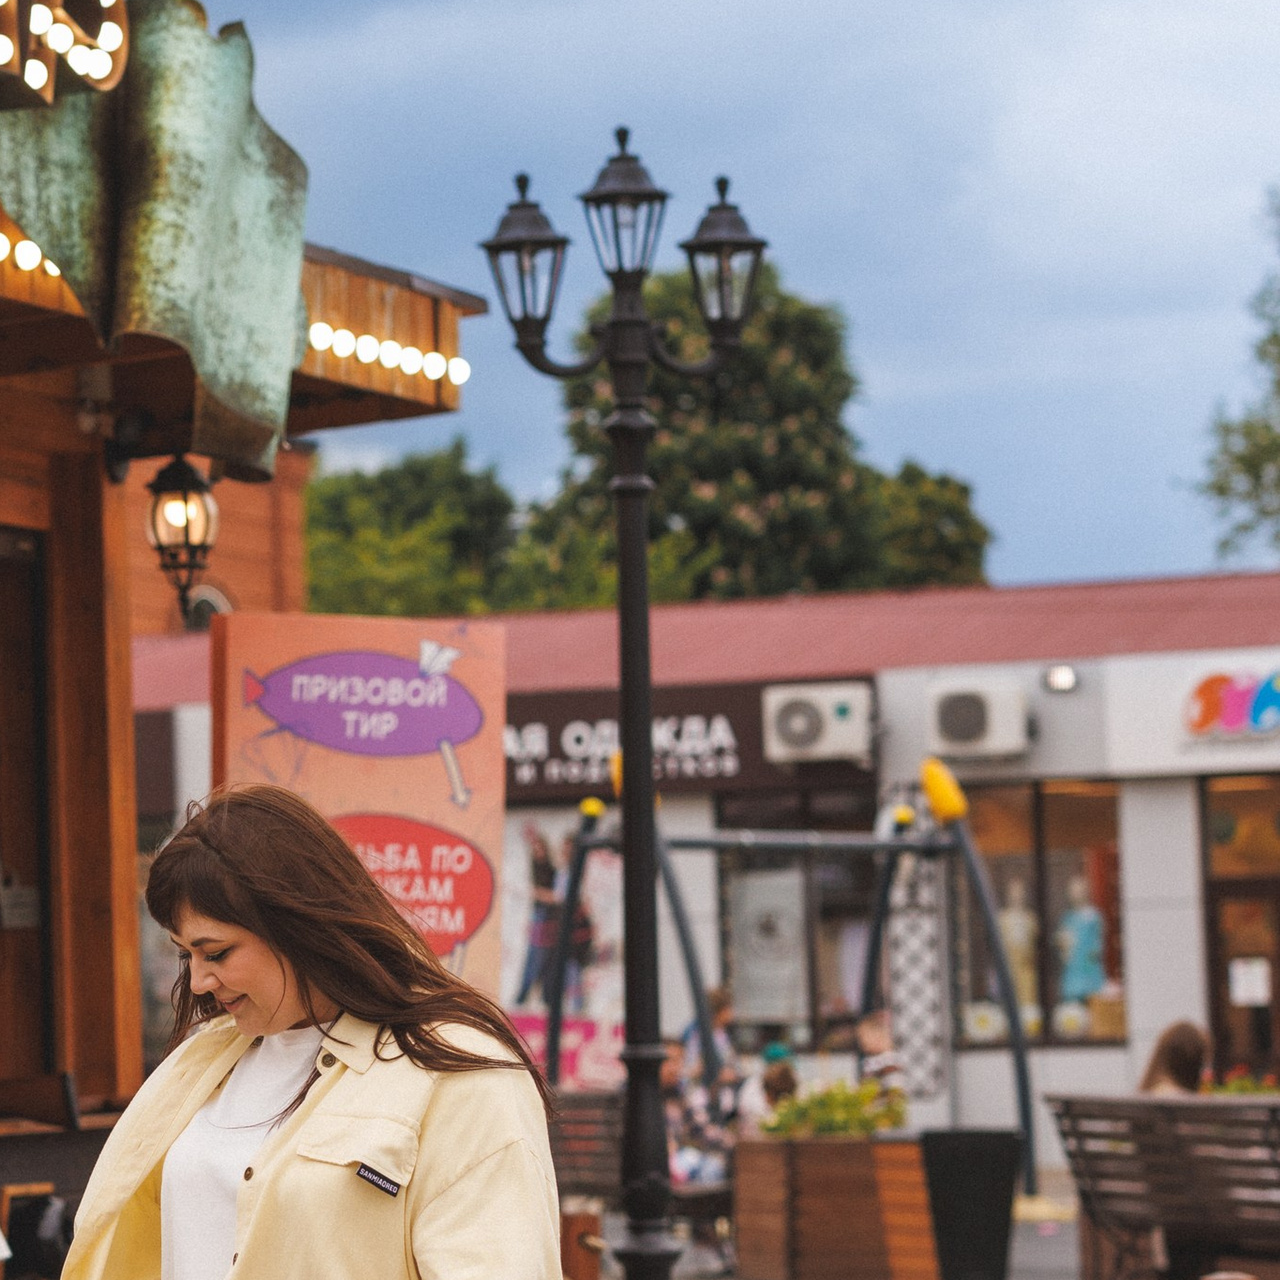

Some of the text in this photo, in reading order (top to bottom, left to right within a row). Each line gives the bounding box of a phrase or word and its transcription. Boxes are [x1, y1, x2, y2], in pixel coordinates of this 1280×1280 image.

[291, 674, 448, 708] ПРИЗОВОЙ
[342, 710, 400, 740] ТИР
[430, 845, 472, 874] ПО
